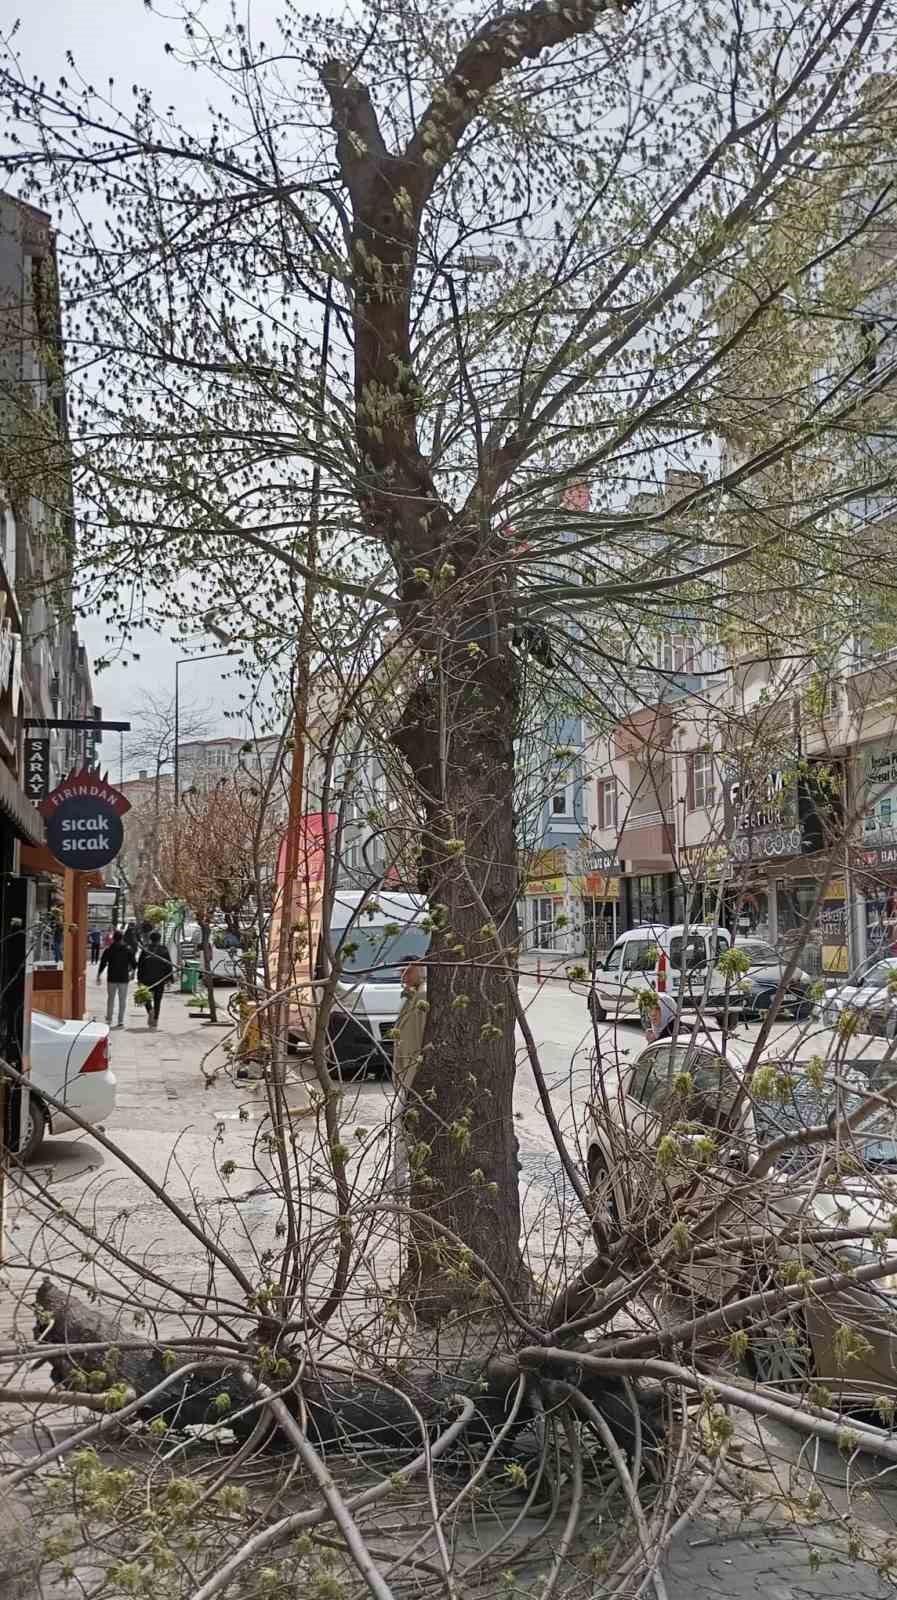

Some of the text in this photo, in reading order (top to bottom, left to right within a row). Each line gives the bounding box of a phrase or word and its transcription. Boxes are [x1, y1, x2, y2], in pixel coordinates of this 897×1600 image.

[29, 741, 44, 794] SARAY
[51, 785, 118, 806] FIRINDAN
[61, 814, 109, 832] sıcak
[61, 834, 110, 851] sıcak
